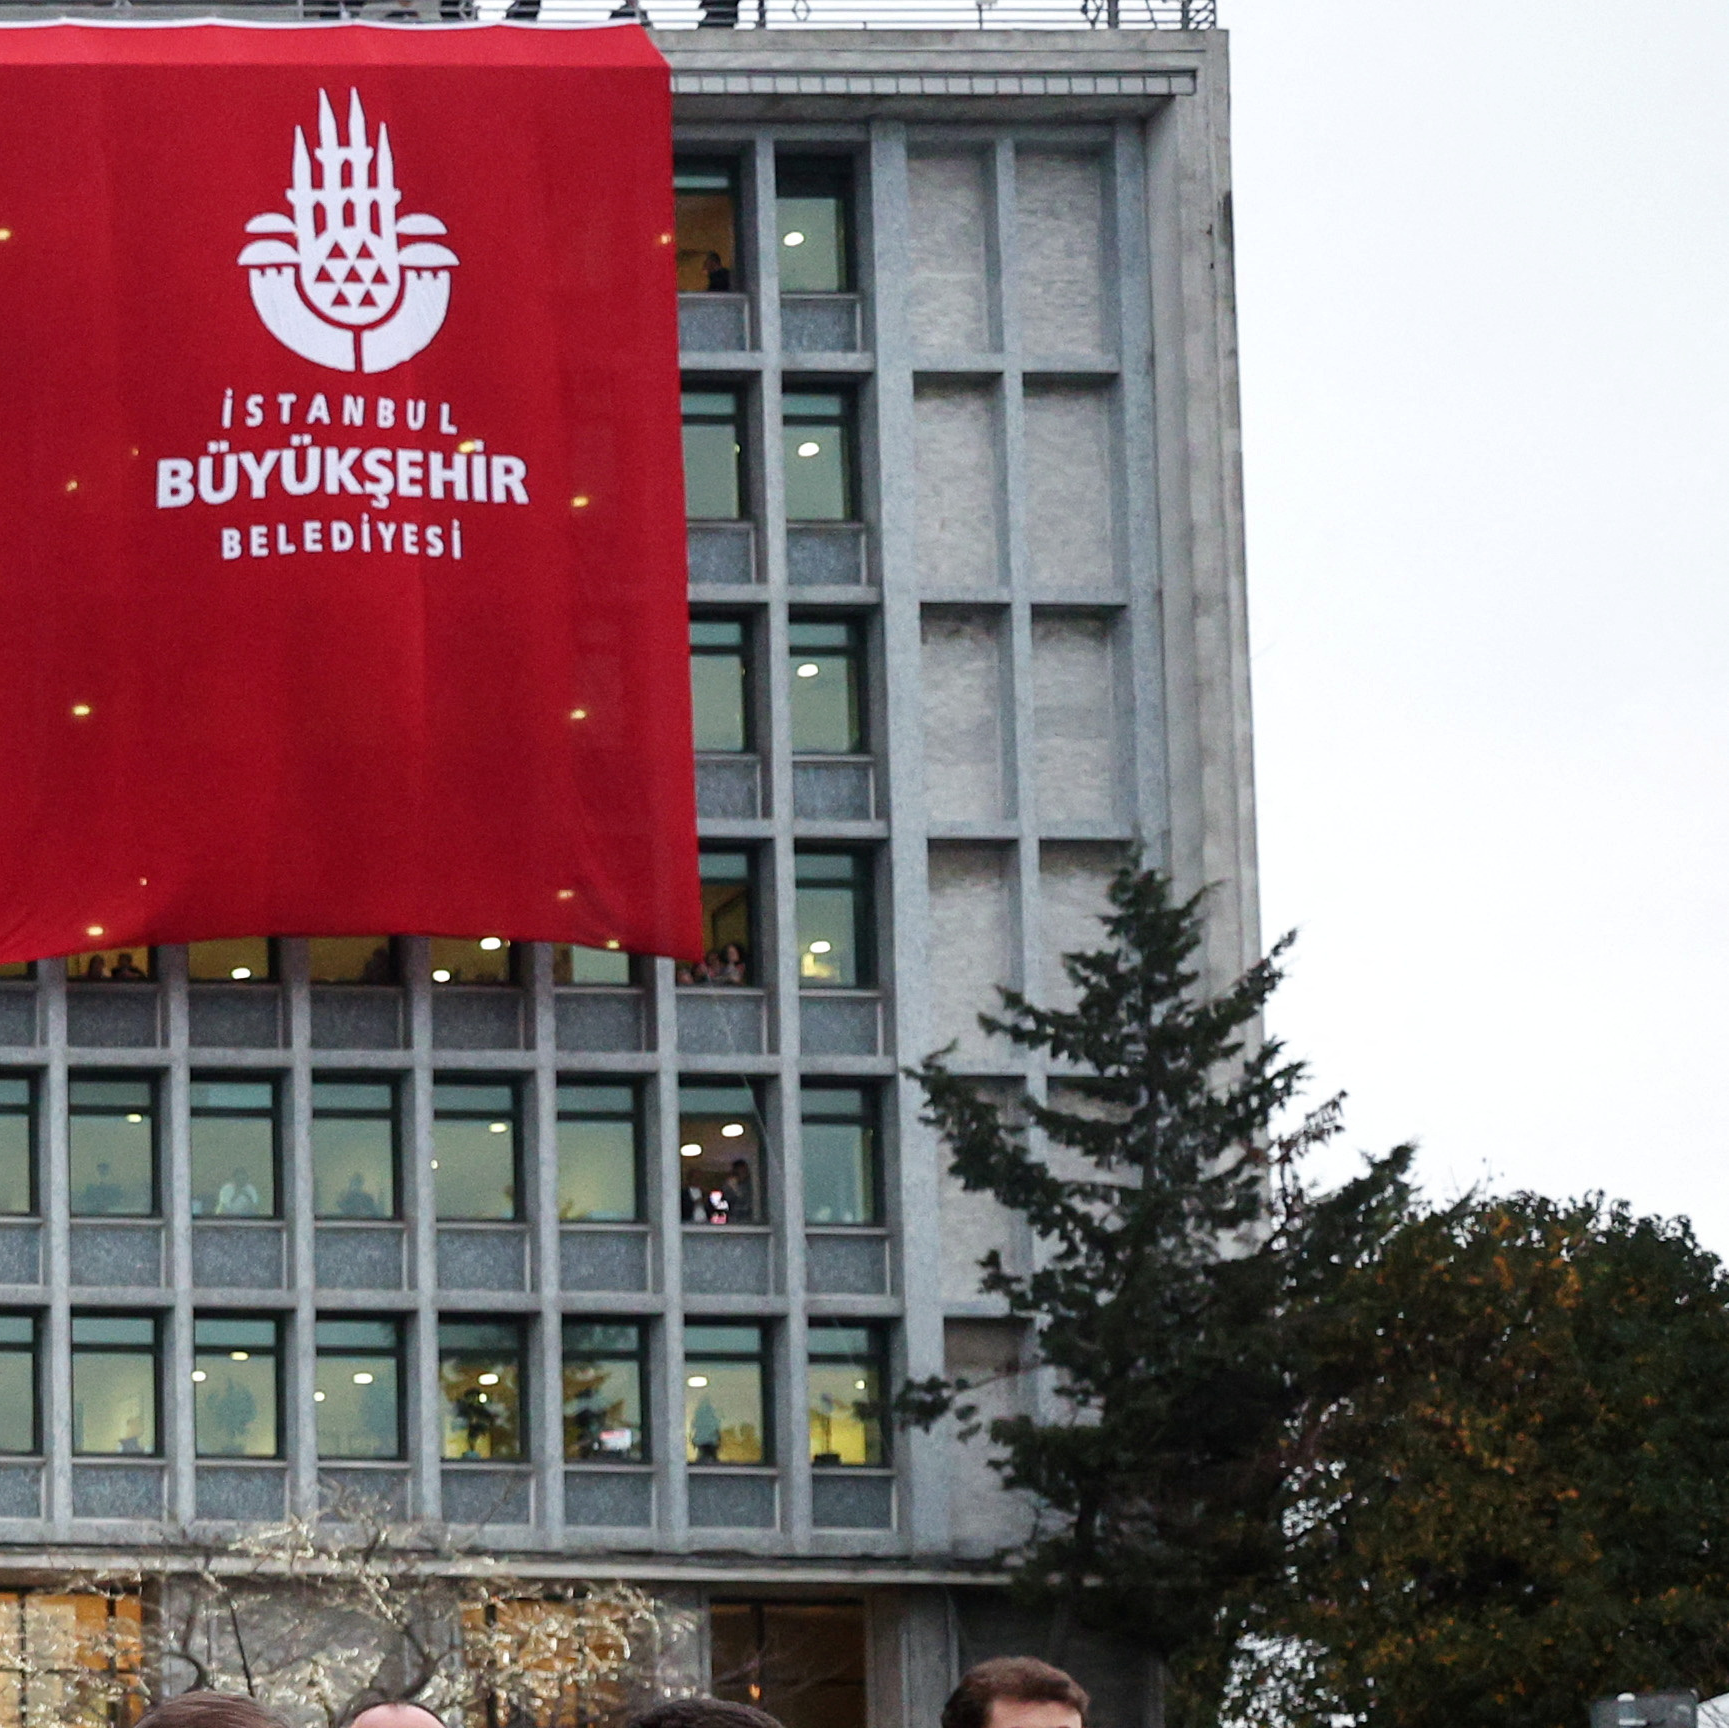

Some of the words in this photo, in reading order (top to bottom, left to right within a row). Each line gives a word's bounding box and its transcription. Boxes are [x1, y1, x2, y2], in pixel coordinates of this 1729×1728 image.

[222, 388, 458, 434] İSTANBUL
[156, 433, 529, 509] BÜYÜKŞEHİR
[222, 513, 462, 560] BELEDİYESİ
